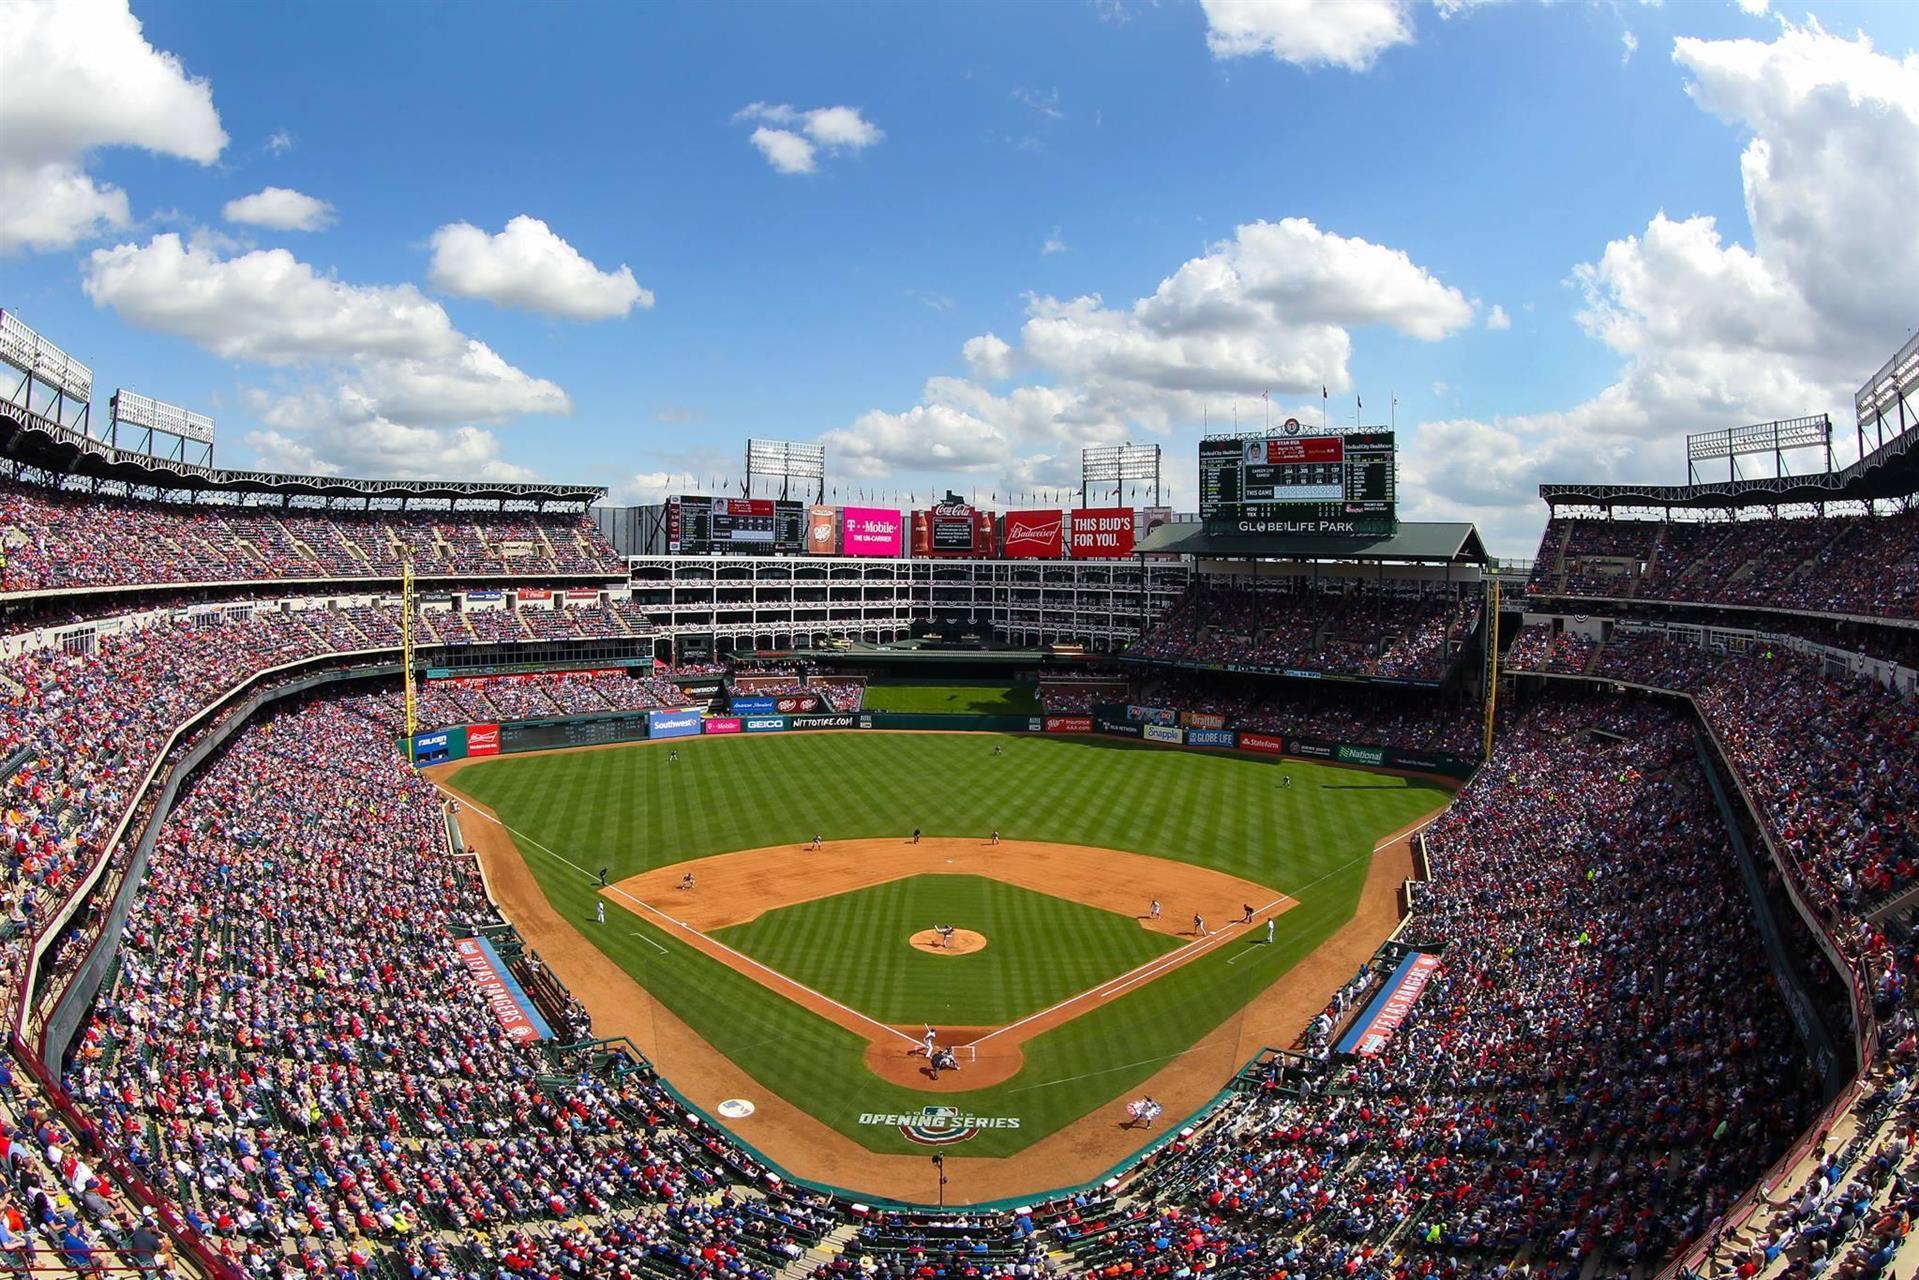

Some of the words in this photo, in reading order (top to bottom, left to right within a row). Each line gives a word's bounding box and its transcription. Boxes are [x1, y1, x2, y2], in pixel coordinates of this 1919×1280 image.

[1074, 518, 1099, 531] THIS
[1100, 517, 1130, 531] BUD'S
[1287, 521, 1315, 532] LIFE
[1320, 521, 1354, 532] PARK
[1012, 527, 1056, 539] Budweiser
[1074, 534, 1097, 547] FOR
[1097, 533, 1119, 547] YOU.
[654, 719, 691, 730] Southwest
[748, 720, 783, 729] GEICO
[793, 717, 853, 728] NITTOTIRE.COM
[1148, 726, 1178, 740] Snapple
[1197, 732, 1218, 743] GLOBE
[1219, 733, 1233, 745] LIFE
[1348, 748, 1382, 761] National
[467, 955, 496, 982] TEXAS
[481, 982, 523, 1023] RANGERS
[1373, 1002, 1408, 1032] TEXAS
[1393, 967, 1430, 1003] RANGERS
[858, 1112, 946, 1128] OPENING
[950, 1116, 1021, 1129] SERIES
